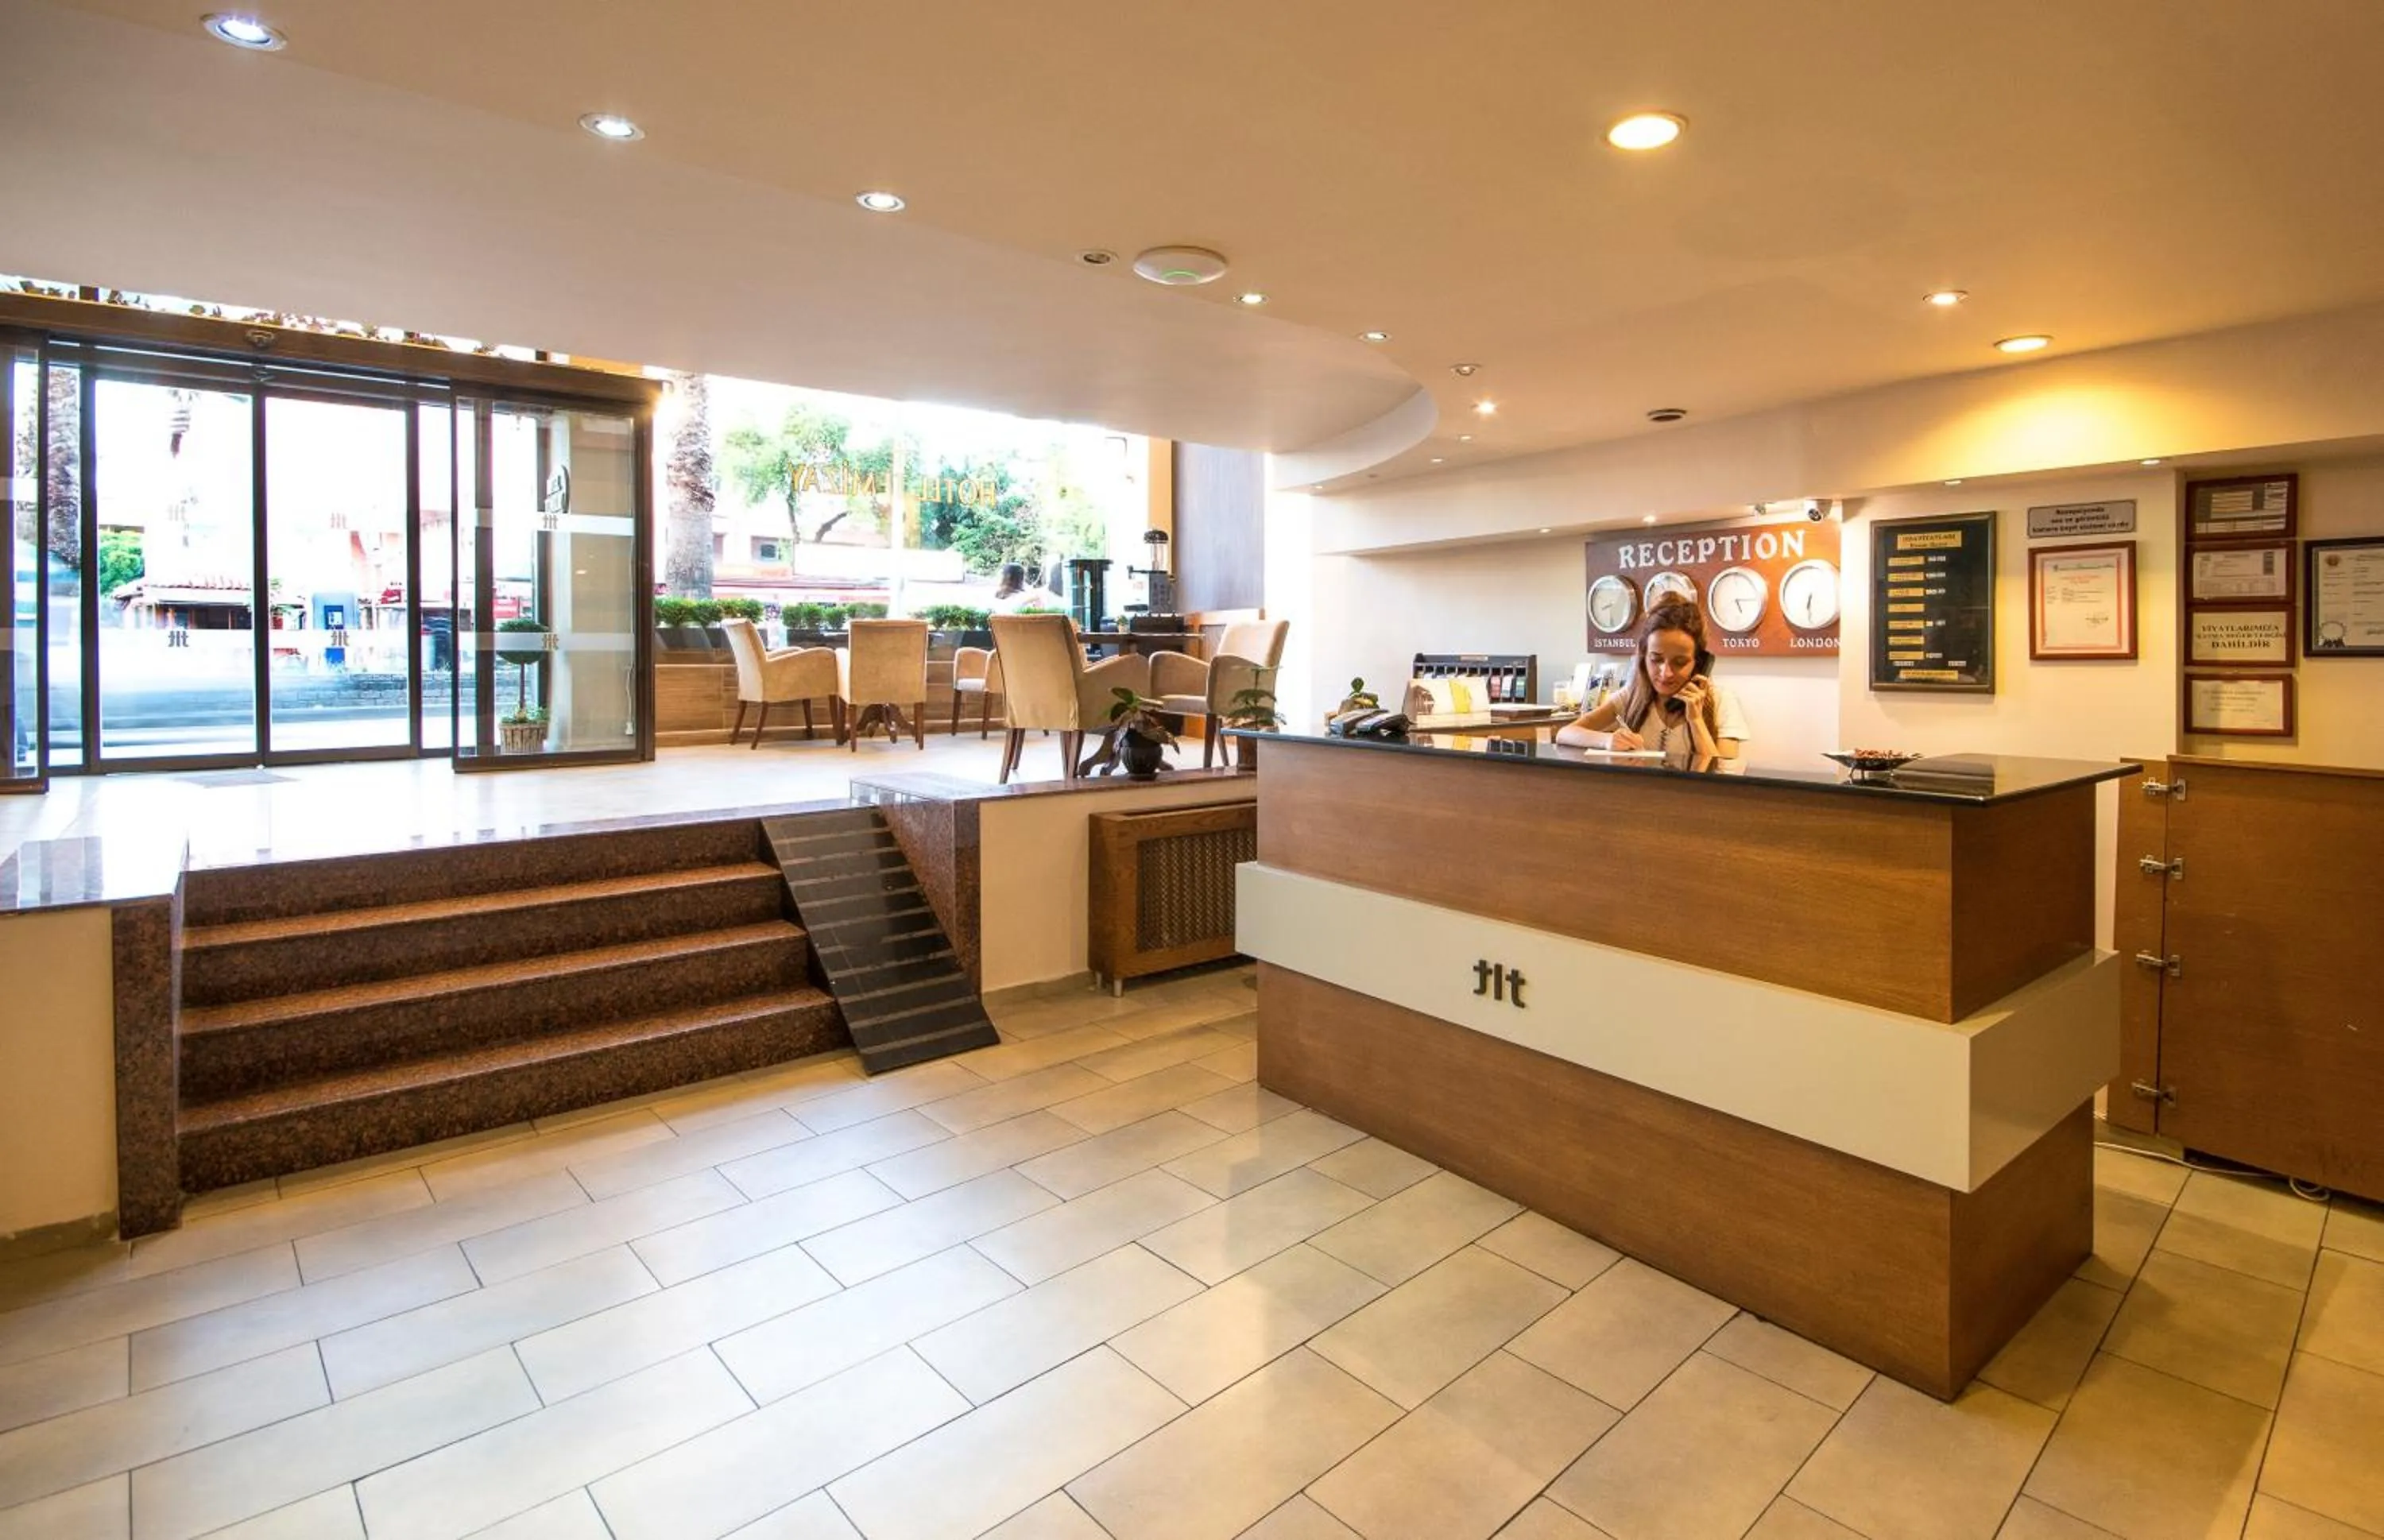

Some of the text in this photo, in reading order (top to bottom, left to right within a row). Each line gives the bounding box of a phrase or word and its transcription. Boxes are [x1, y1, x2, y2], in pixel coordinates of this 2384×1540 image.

[1618, 529, 1805, 570] RECEPTION
[1722, 637, 1761, 648] TOKYO
[1790, 637, 1842, 649] LONDON
